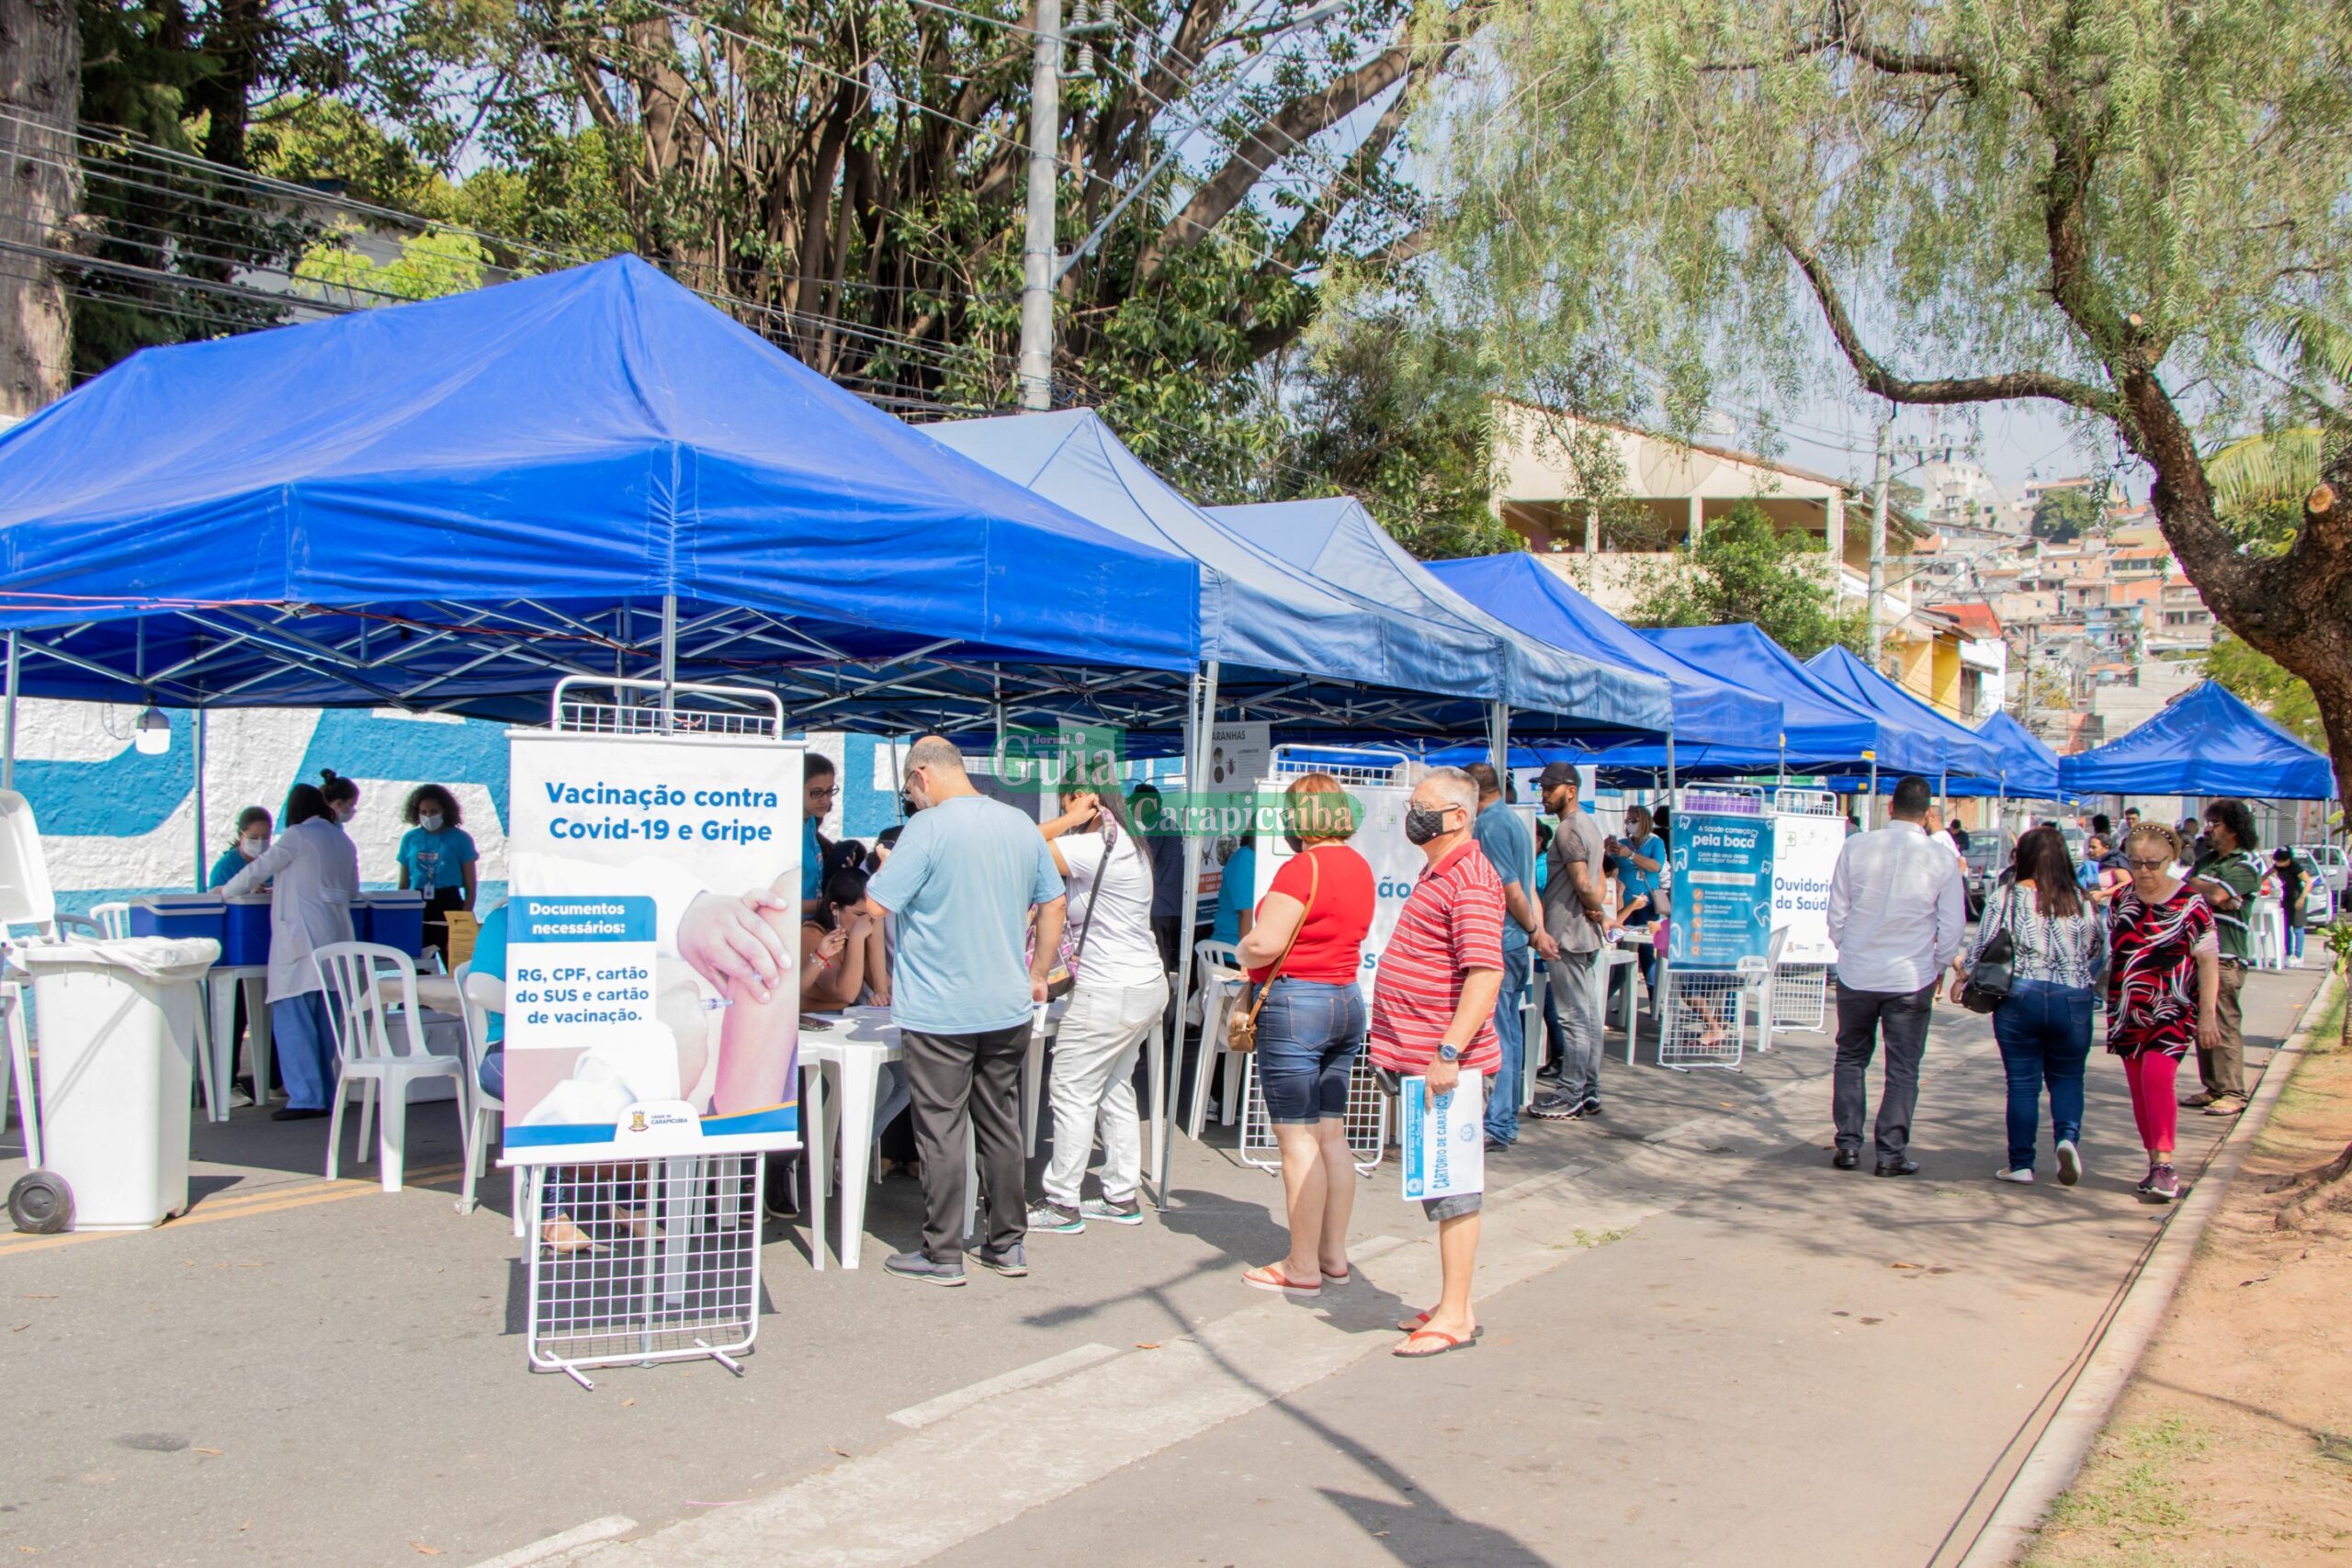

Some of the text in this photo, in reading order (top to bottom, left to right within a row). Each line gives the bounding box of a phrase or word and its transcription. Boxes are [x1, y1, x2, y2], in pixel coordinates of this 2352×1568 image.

[1213, 730, 1246, 740] ARANHAS
[545, 781, 778, 810] Vacinação contra
[549, 817, 773, 845] Covid-19 e Gripe
[1692, 834, 1755, 848] pela boca
[529, 902, 626, 915] Documentos
[1776, 895, 1827, 910] da Saúd
[532, 920, 626, 934] necessários:
[517, 966, 649, 983] RG, CPF, cartão
[515, 987, 650, 1003] do SUS e cartão
[527, 1008, 642, 1025] de vacinação.
[1432, 1093, 1450, 1190] CARTÓRIO DE CARAPICU
